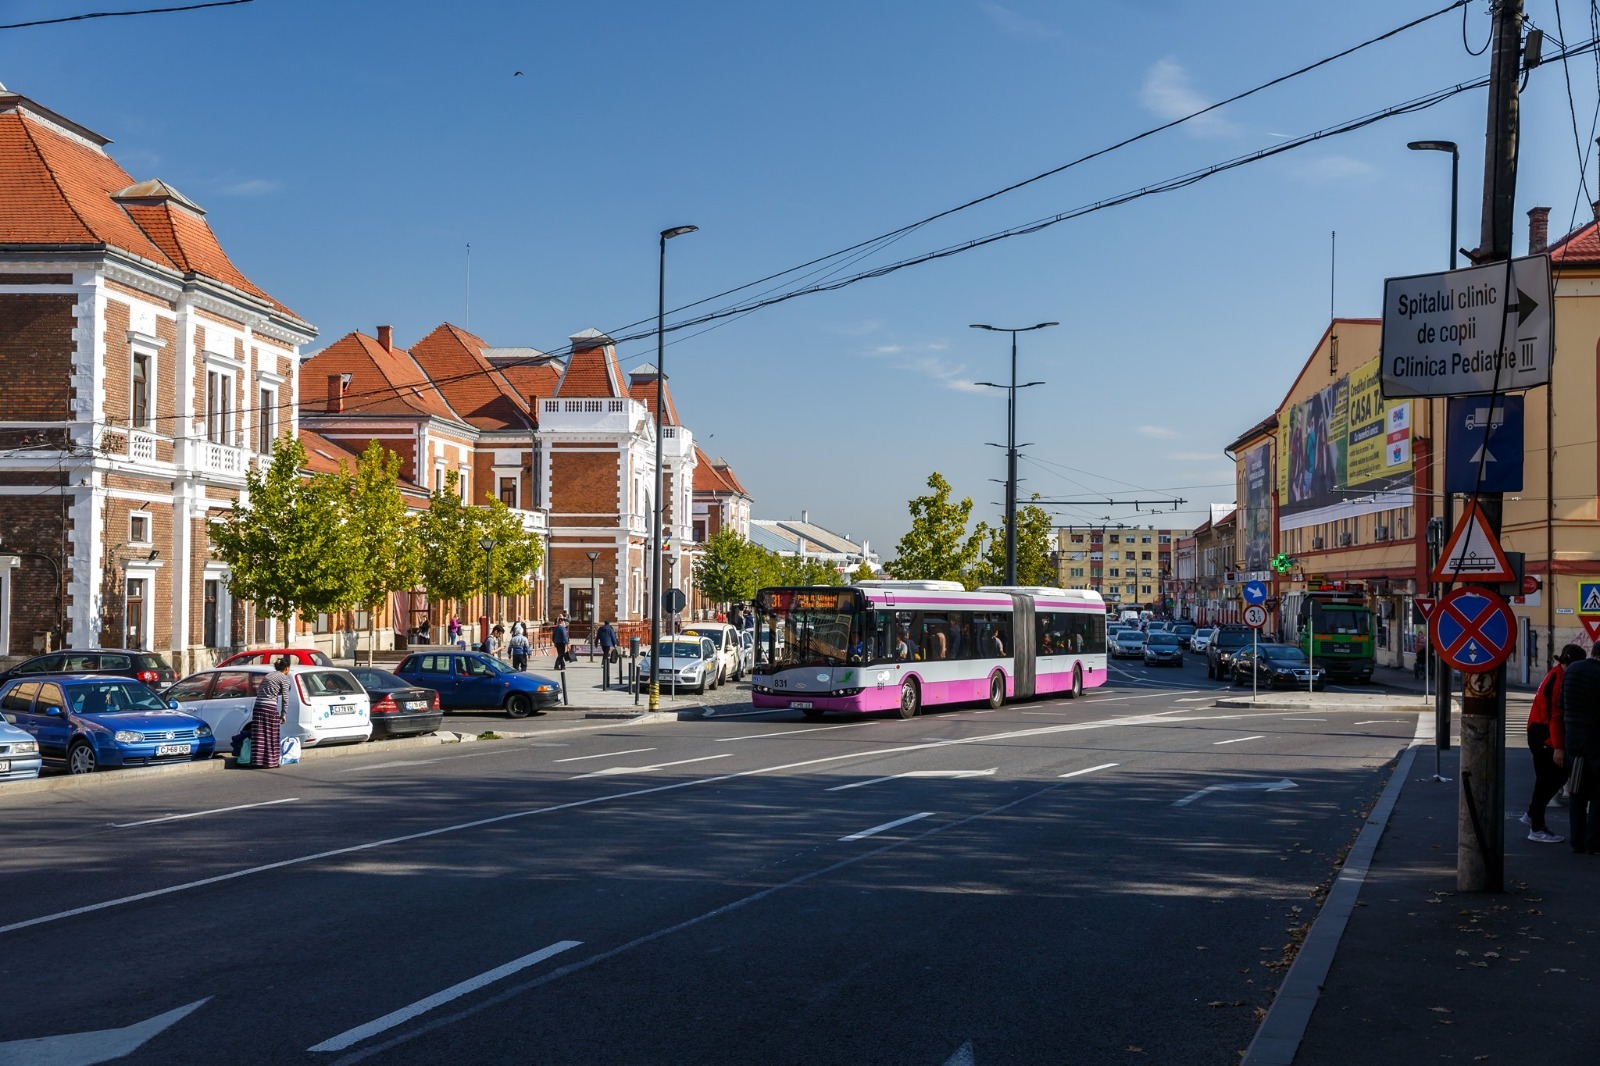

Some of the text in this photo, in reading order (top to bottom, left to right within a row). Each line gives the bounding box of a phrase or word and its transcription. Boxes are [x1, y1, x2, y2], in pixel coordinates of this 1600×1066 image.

[1398, 283, 1497, 320] Spitalul clinic
[1417, 316, 1476, 346] de copii
[1393, 355, 1446, 377] Clinica
[1452, 346, 1516, 374] Pediatrie
[1350, 393, 1371, 427] CASA
[771, 594, 780, 608] 31
[774, 680, 788, 688] 831
